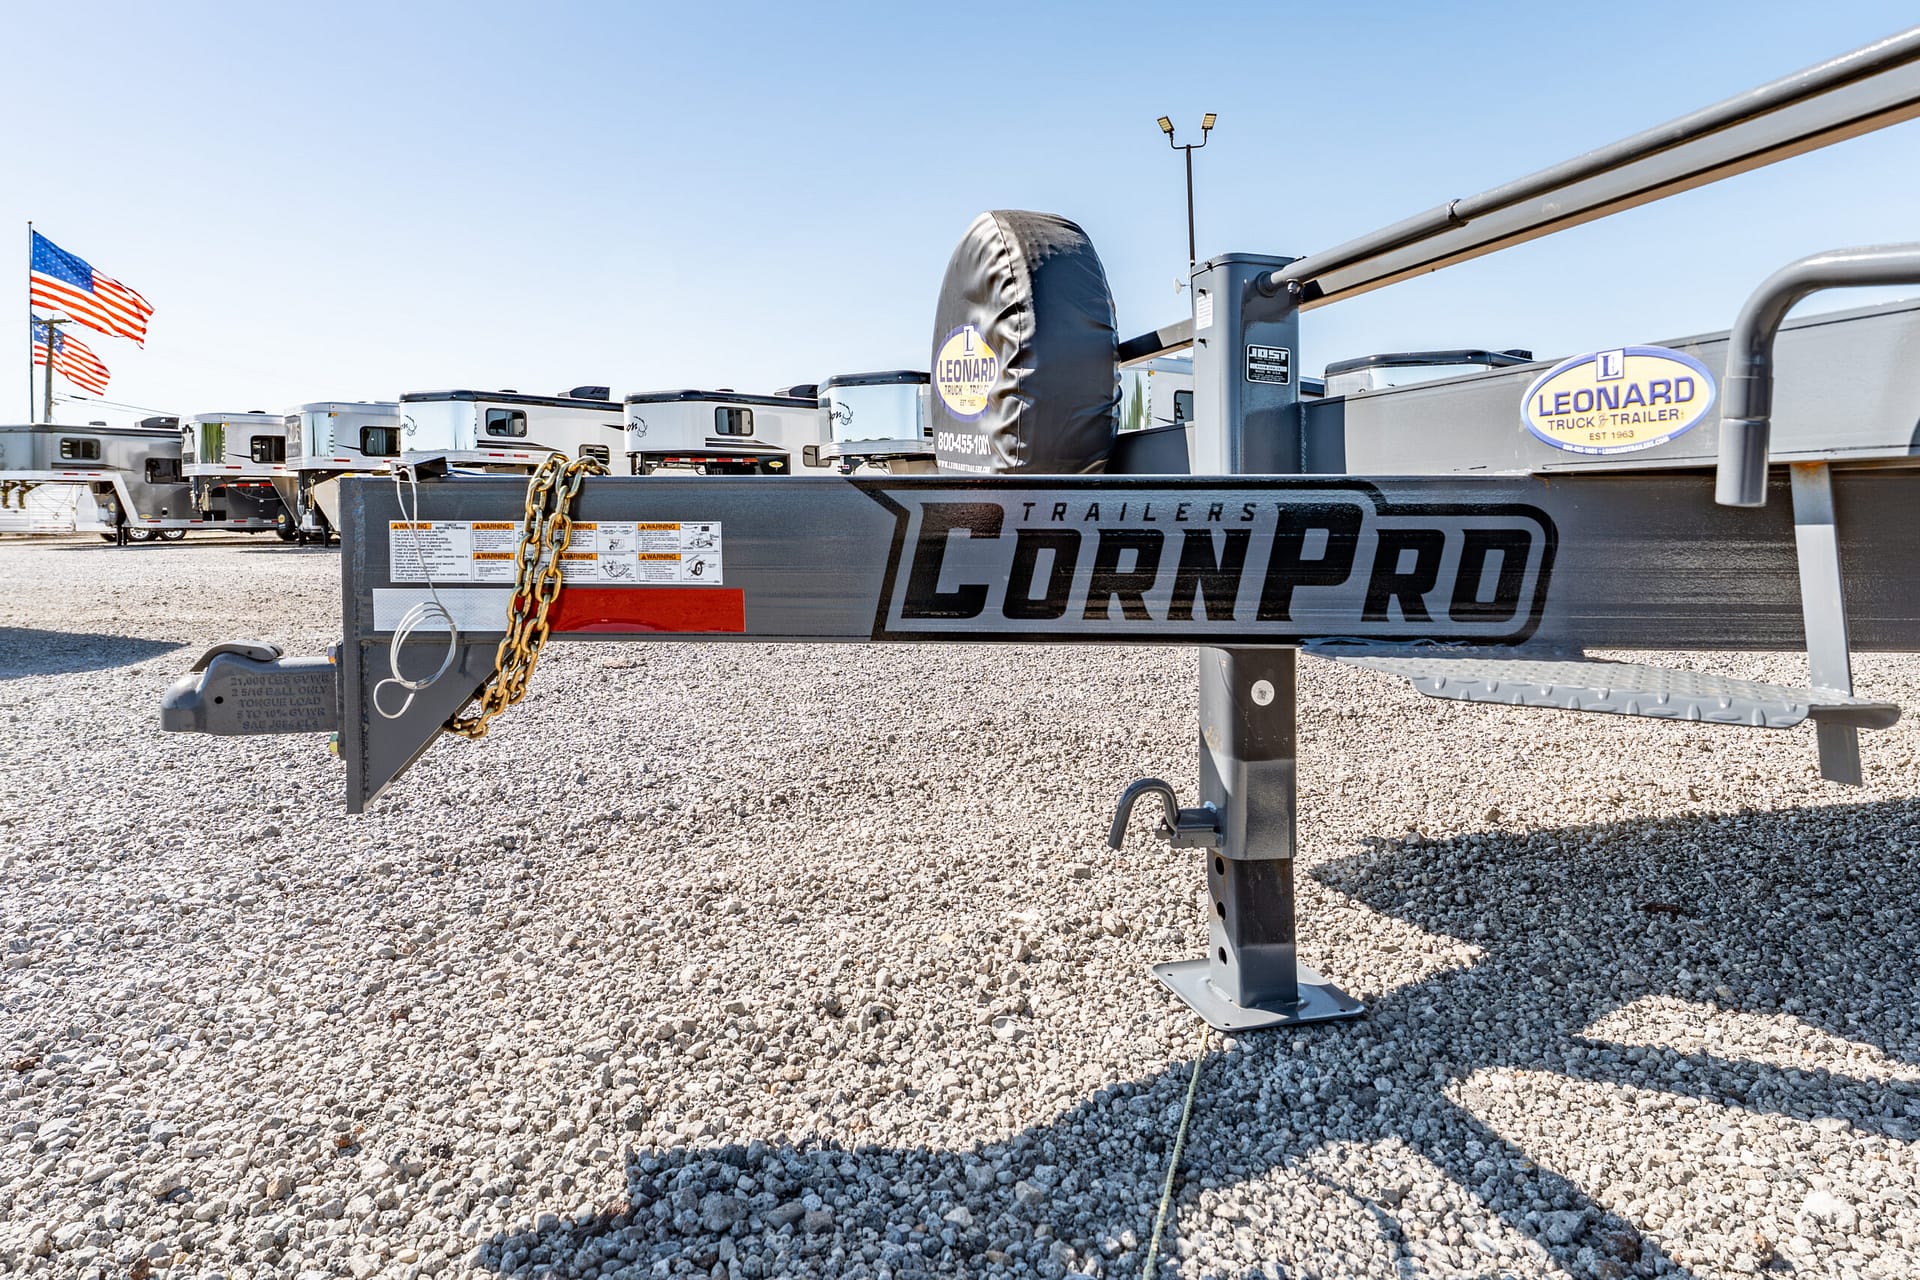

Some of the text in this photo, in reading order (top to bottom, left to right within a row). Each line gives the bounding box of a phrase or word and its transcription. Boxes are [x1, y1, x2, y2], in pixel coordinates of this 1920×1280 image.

[1249, 347, 1288, 360] JOST
[940, 357, 996, 383] LEONARD
[1538, 376, 1695, 417] LEONARD
[1548, 415, 1595, 431] TRUCK
[1611, 408, 1679, 426] TRAILER
[1589, 430, 1634, 441] EST 1963
[1021, 502, 1259, 522] TRAILERS
[231, 688, 238, 697] 2
[266, 687, 295, 696] BALL
[298, 686, 328, 695] ONLY
[240, 697, 321, 708] TONGUE LOAD
[289, 707, 326, 717] GVWR
